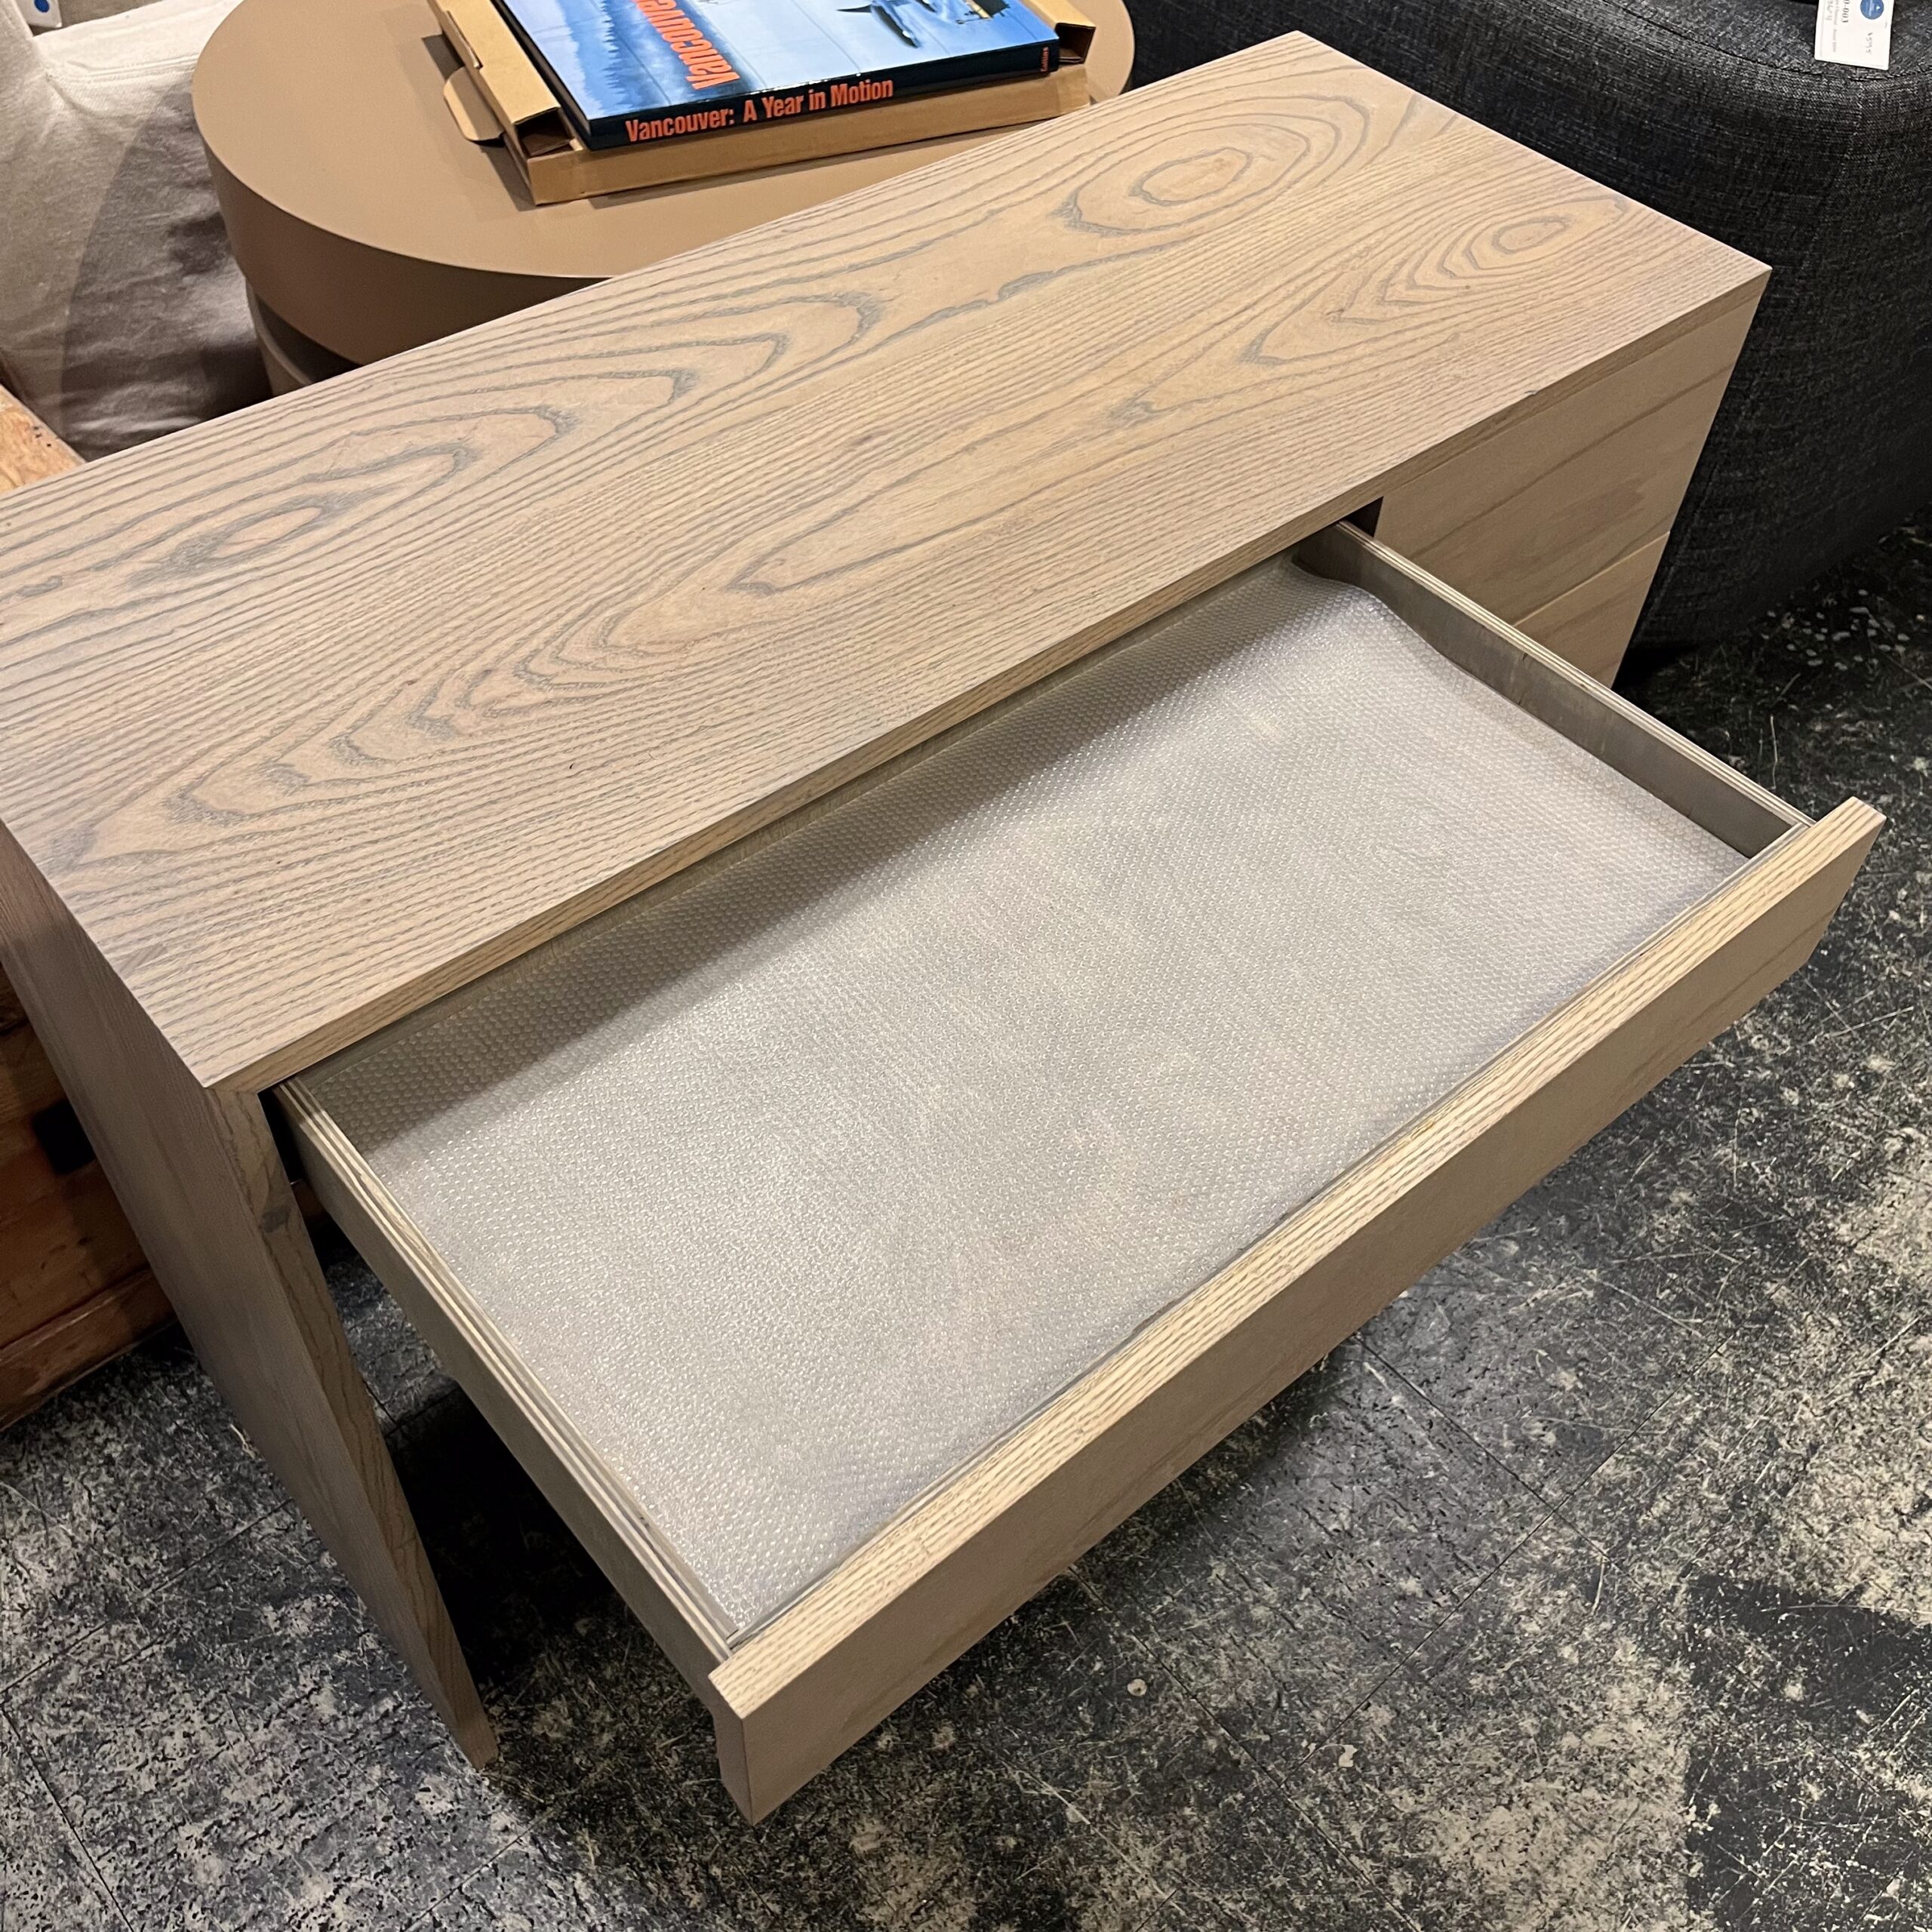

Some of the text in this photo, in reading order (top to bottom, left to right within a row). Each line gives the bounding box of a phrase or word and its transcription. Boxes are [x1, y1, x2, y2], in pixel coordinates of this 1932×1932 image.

[629, 0, 740, 90] Vancouve
[625, 79, 894, 142] Vancouver: A Year in Motion
